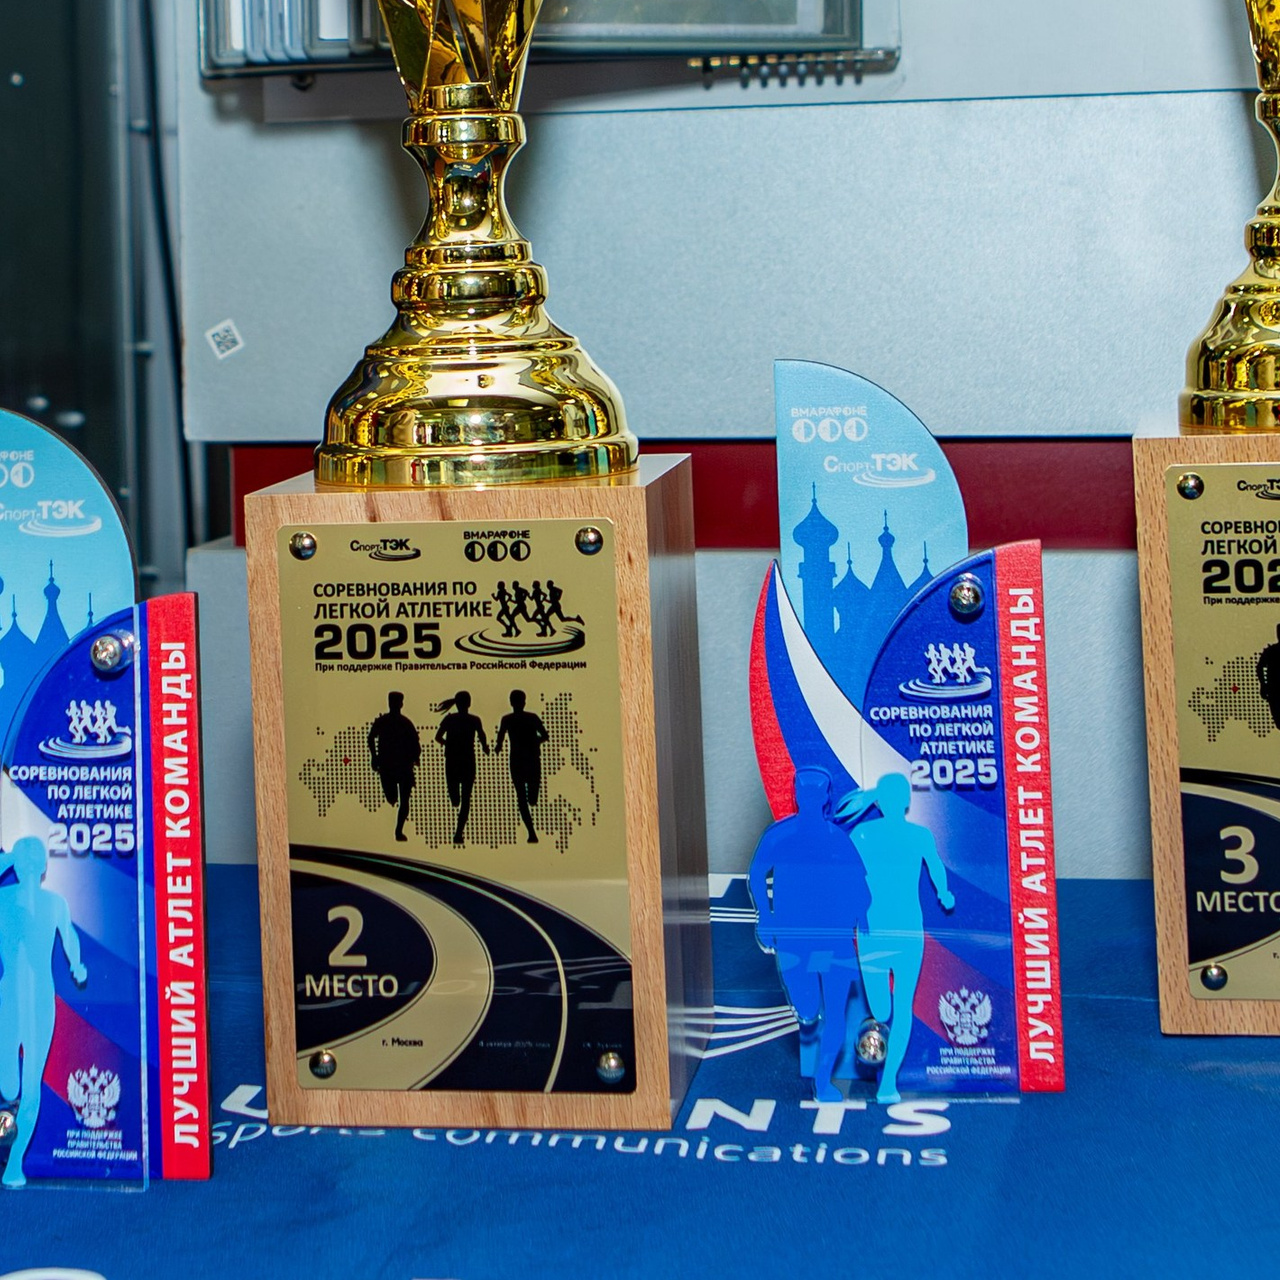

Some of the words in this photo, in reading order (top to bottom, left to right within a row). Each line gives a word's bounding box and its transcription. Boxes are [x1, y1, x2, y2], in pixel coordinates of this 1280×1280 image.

[791, 406, 867, 417] ВМАРАФОНЕ
[463, 529, 530, 540] ВМАРАФОНЕ
[1201, 520, 1280, 535] СОРЕВНО
[1201, 535, 1278, 555] ЛЕГКОЙ
[313, 582, 447, 598] СОРЕВНОВАНИЯ
[452, 582, 477, 596] ПО
[314, 598, 389, 620] ЛЕГКОЙ
[395, 600, 492, 618] АТЛЕТИКЕ
[1204, 597, 1223, 606] При
[314, 622, 441, 660] 2025
[315, 662, 334, 673] При
[337, 663, 393, 673] поддержке
[395, 661, 467, 671] Правительства
[470, 660, 527, 671] Российской
[529, 660, 587, 671] Федерации
[1009, 587, 1041, 773] КОМАНДЫ
[870, 705, 993, 720] СОРЕВНОВАНИЯ
[161, 641, 192, 838] КОМАНДЫ
[909, 723, 932, 737] ПО
[934, 721, 994, 736] ЛЕГКОЙ
[920, 740, 995, 754] АТЛЕТИКЕ
[9, 765, 132, 782] СОРЕВНОВАНИЯ
[911, 758, 998, 785] 2025
[47, 785, 69, 800] ПО
[73, 783, 132, 801] ЛЕГКОЙ
[57, 804, 133, 819] АТЛЕТИКЕ
[48, 823, 135, 852] 2025
[1018, 786, 1047, 895] АТЛЕТ
[1220, 825, 1259, 884] 3
[166, 852, 194, 967] АТЛЕТ
[327, 904, 367, 967] 2
[305, 974, 398, 998] МЕСТО
[1018, 907, 1055, 1064] ЛУЧШИЙ
[166, 985, 199, 1148] ЛУЧШИЙ
